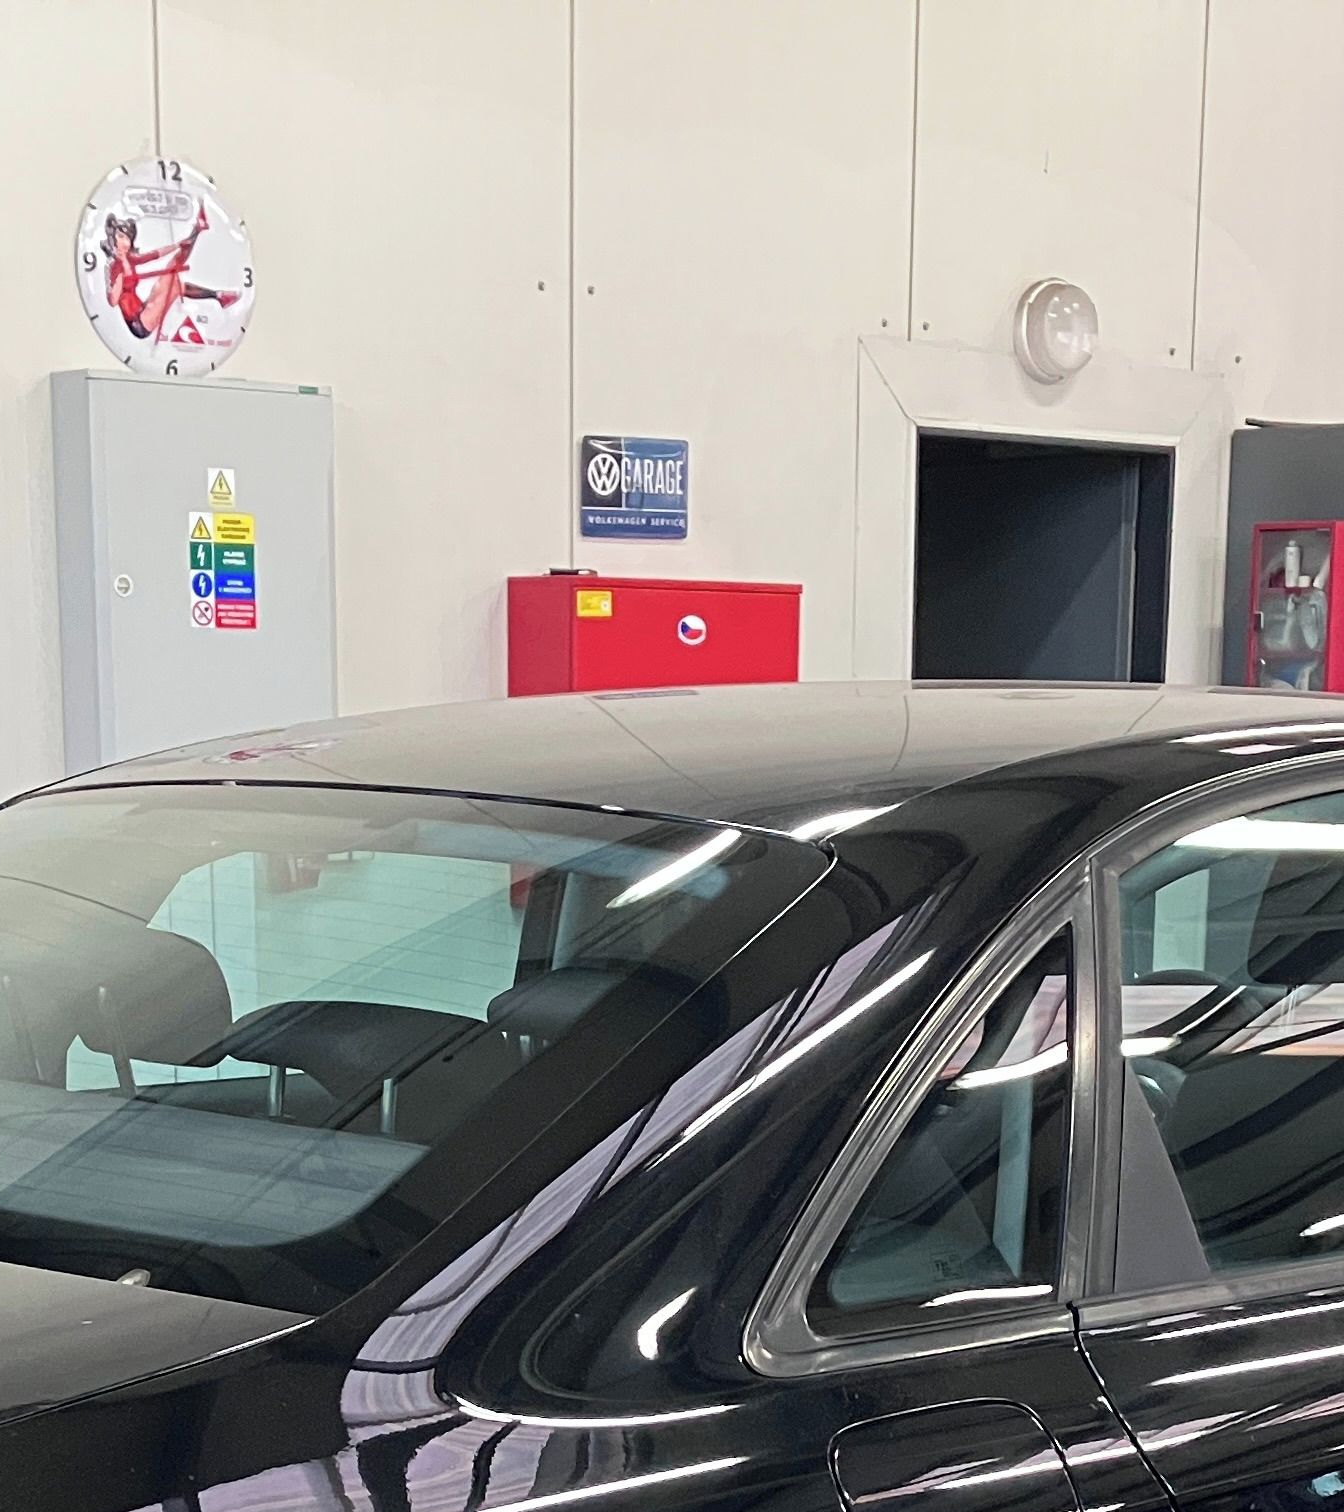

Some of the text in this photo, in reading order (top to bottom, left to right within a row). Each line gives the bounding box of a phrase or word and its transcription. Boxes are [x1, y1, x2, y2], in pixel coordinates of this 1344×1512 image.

[158, 160, 183, 182] 12
[83, 251, 98, 273] 9
[243, 267, 254, 288] 3
[166, 359, 179, 376] 6
[621, 457, 684, 495] GARAGE
